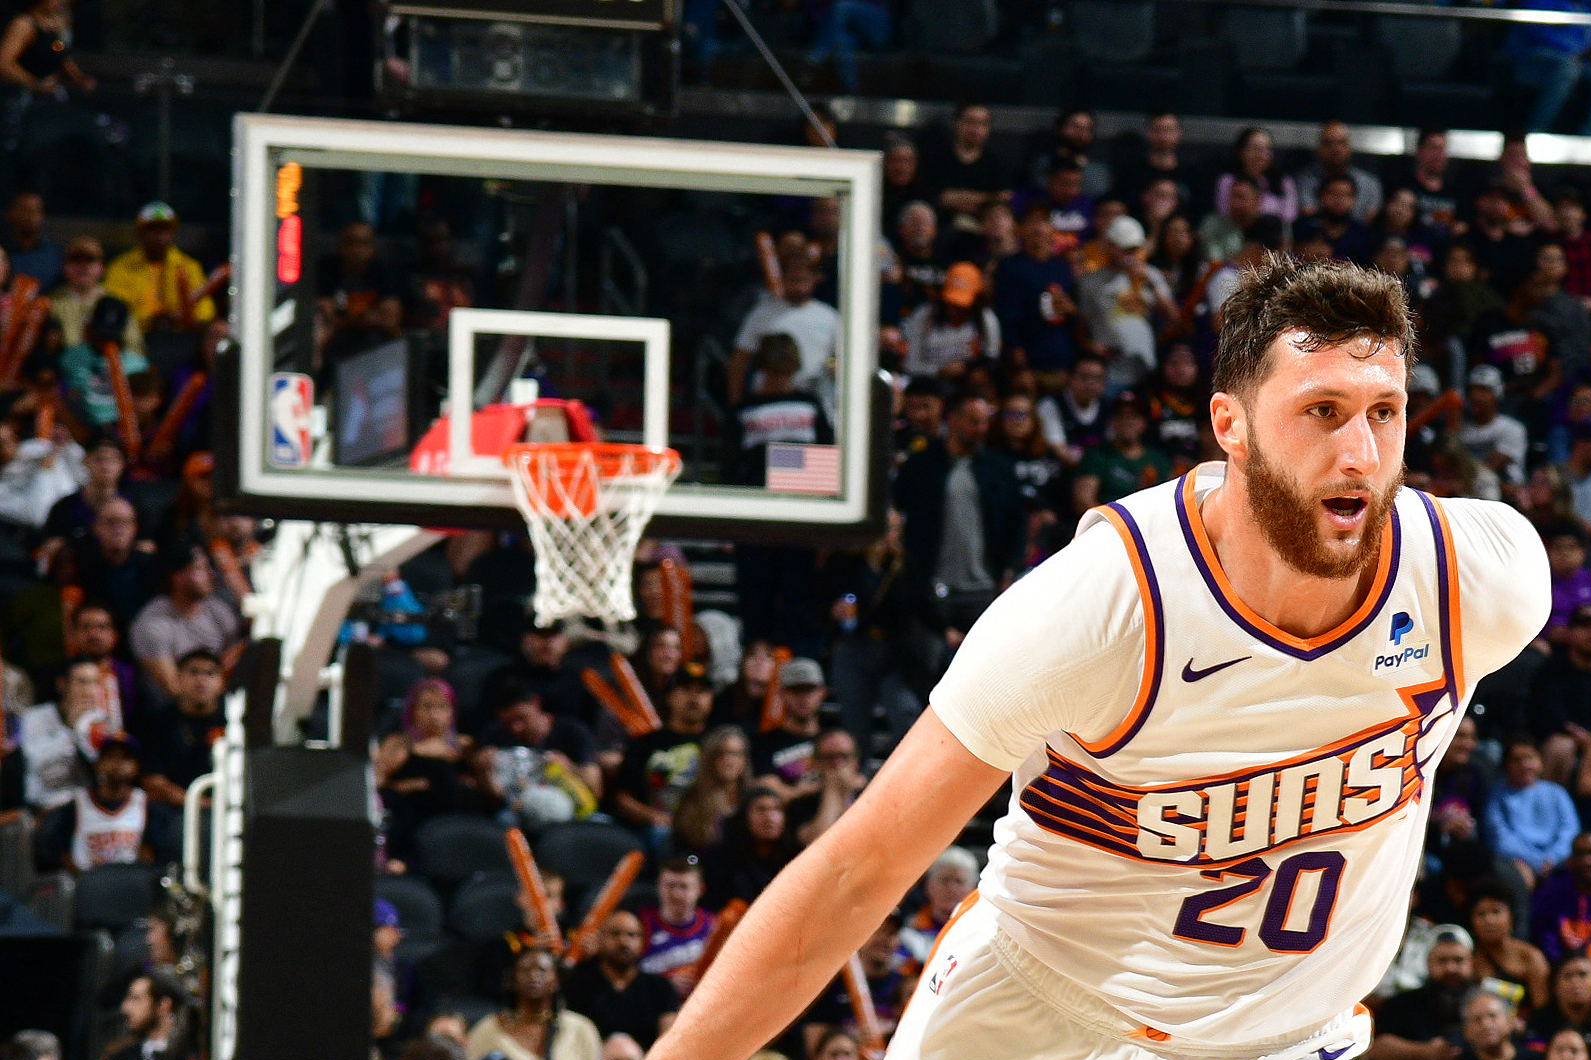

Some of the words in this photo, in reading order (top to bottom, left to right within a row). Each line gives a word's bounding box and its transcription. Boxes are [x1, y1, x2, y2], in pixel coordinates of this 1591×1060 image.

[1374, 643, 1430, 671] PayPal
[1136, 730, 1409, 862] SUNS
[1171, 850, 1348, 954] 20
